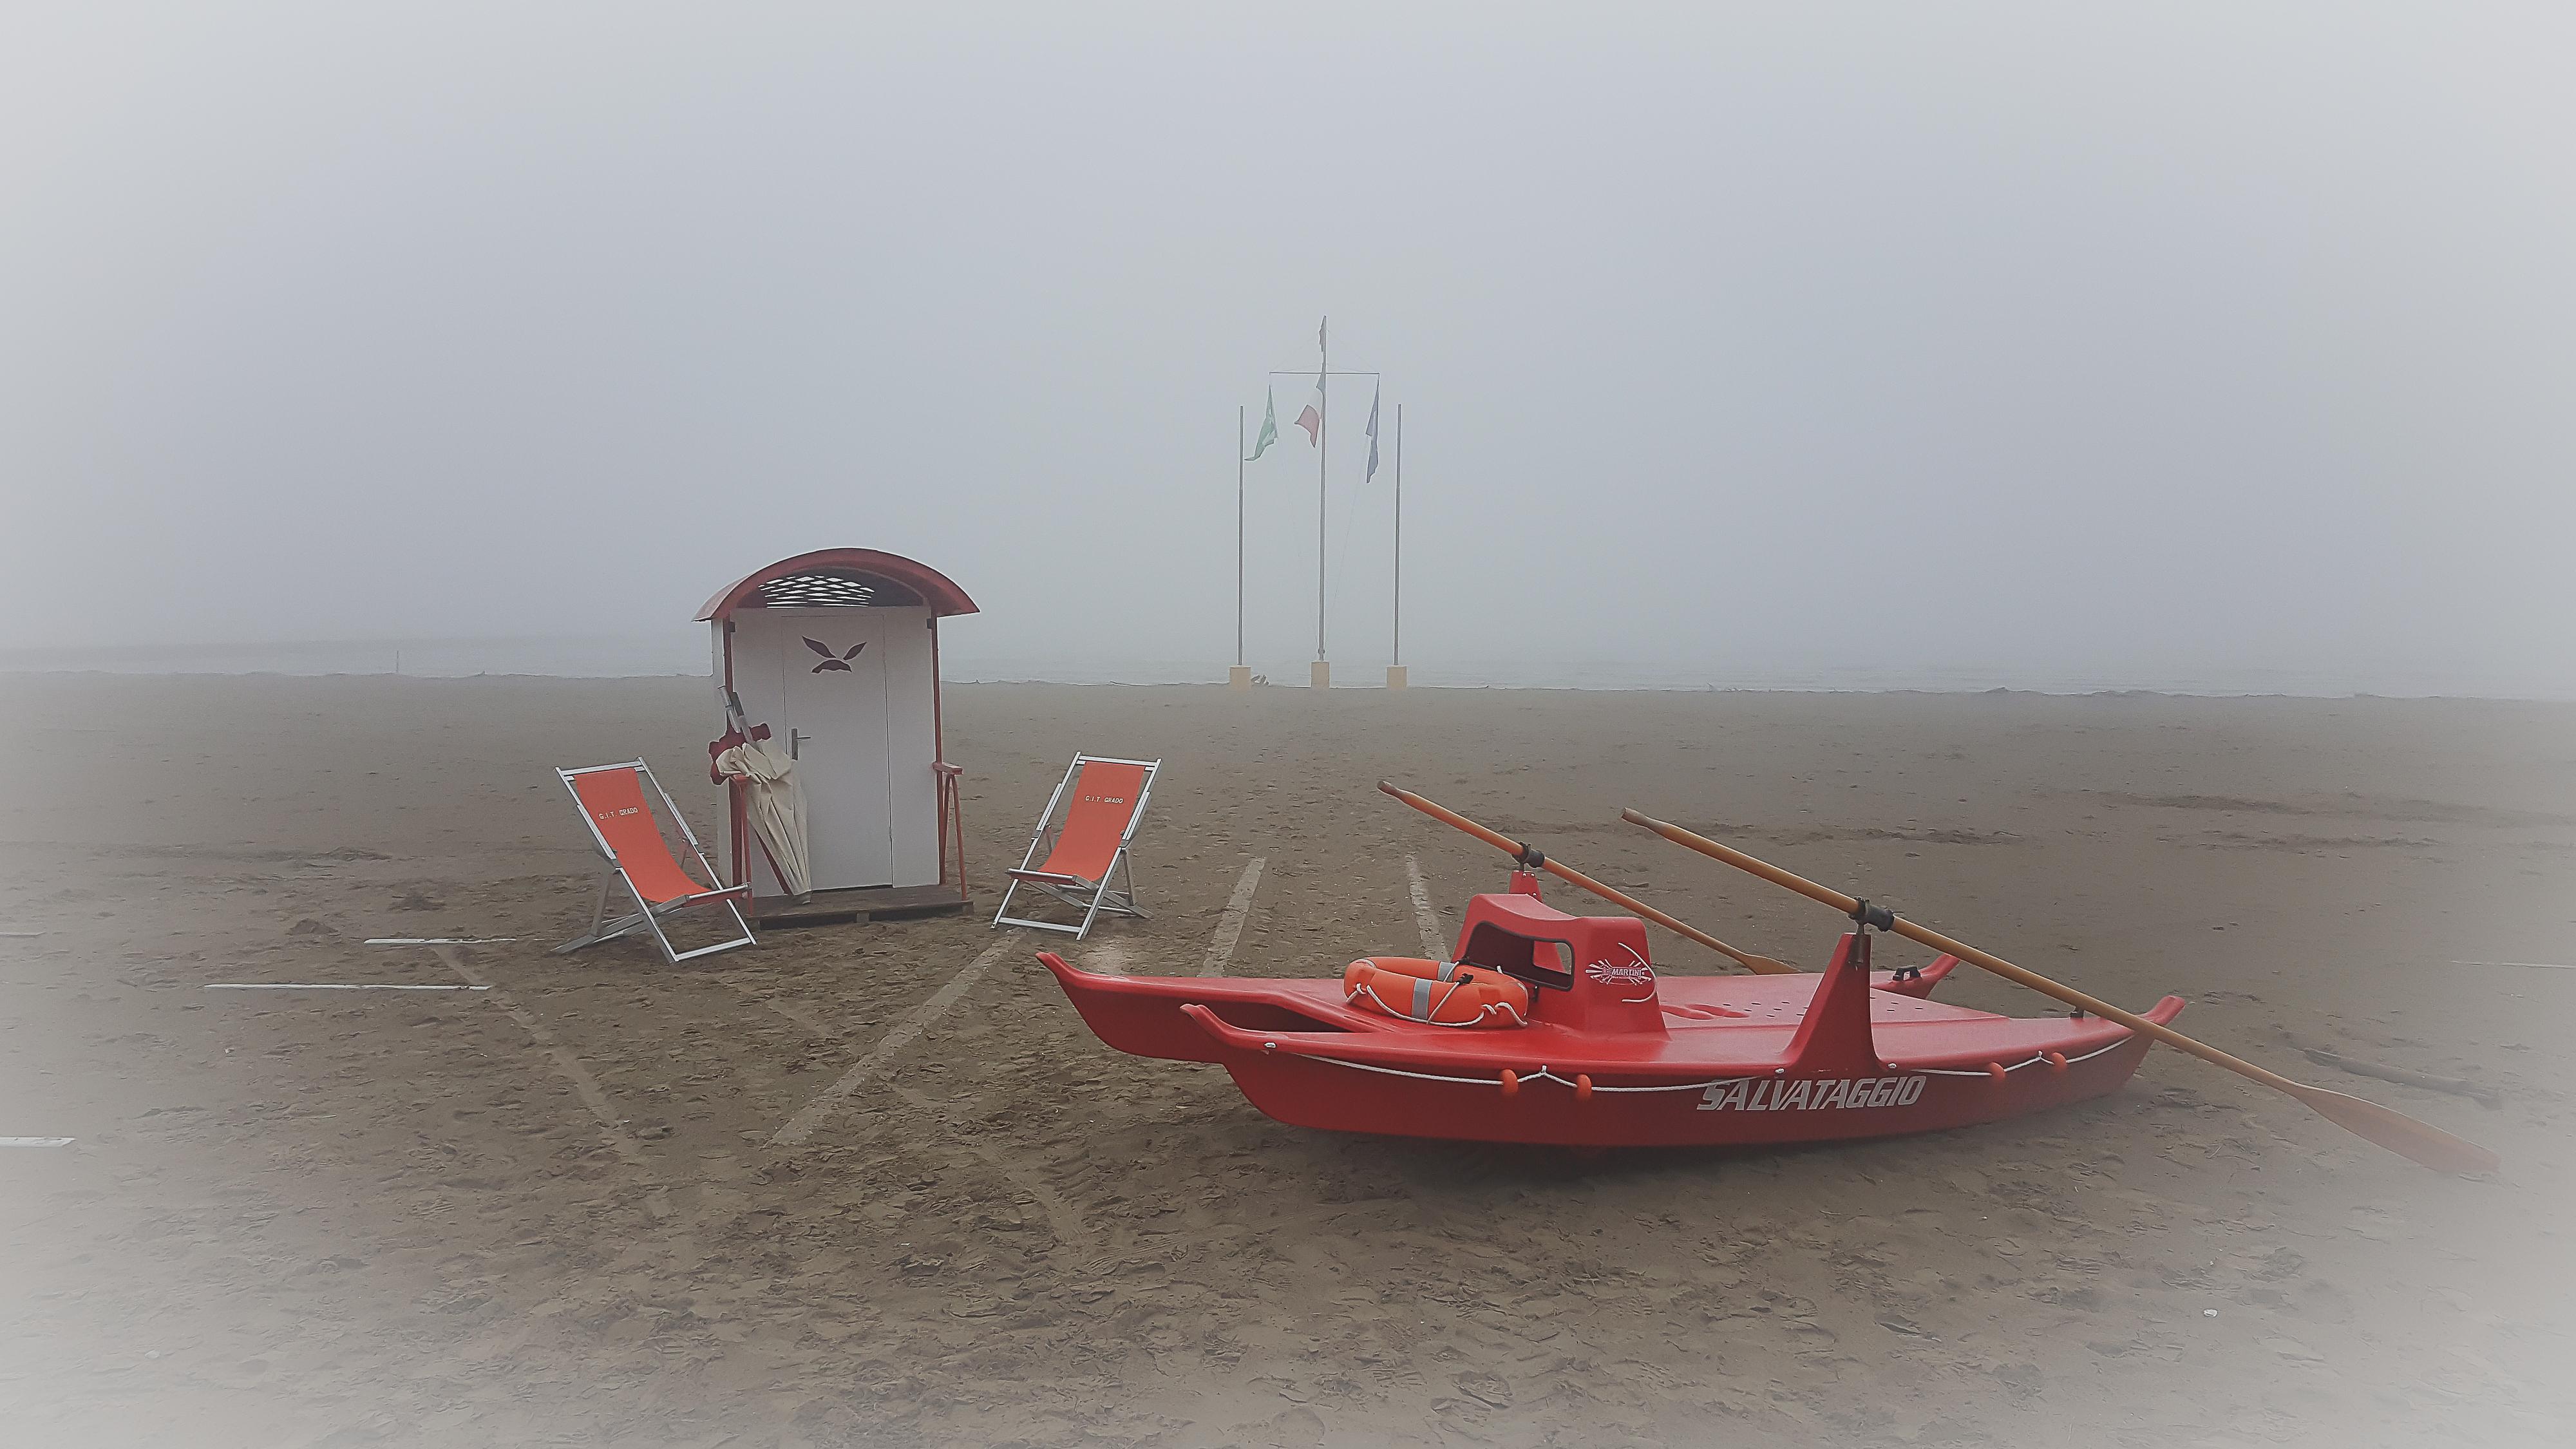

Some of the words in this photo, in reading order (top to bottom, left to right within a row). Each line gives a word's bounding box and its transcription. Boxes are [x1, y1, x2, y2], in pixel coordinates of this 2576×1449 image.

[619, 807, 638, 816] GRADO
[1611, 968, 1642, 976] MARTINI
[1696, 1075, 1926, 1111] SALVATAGGIO
